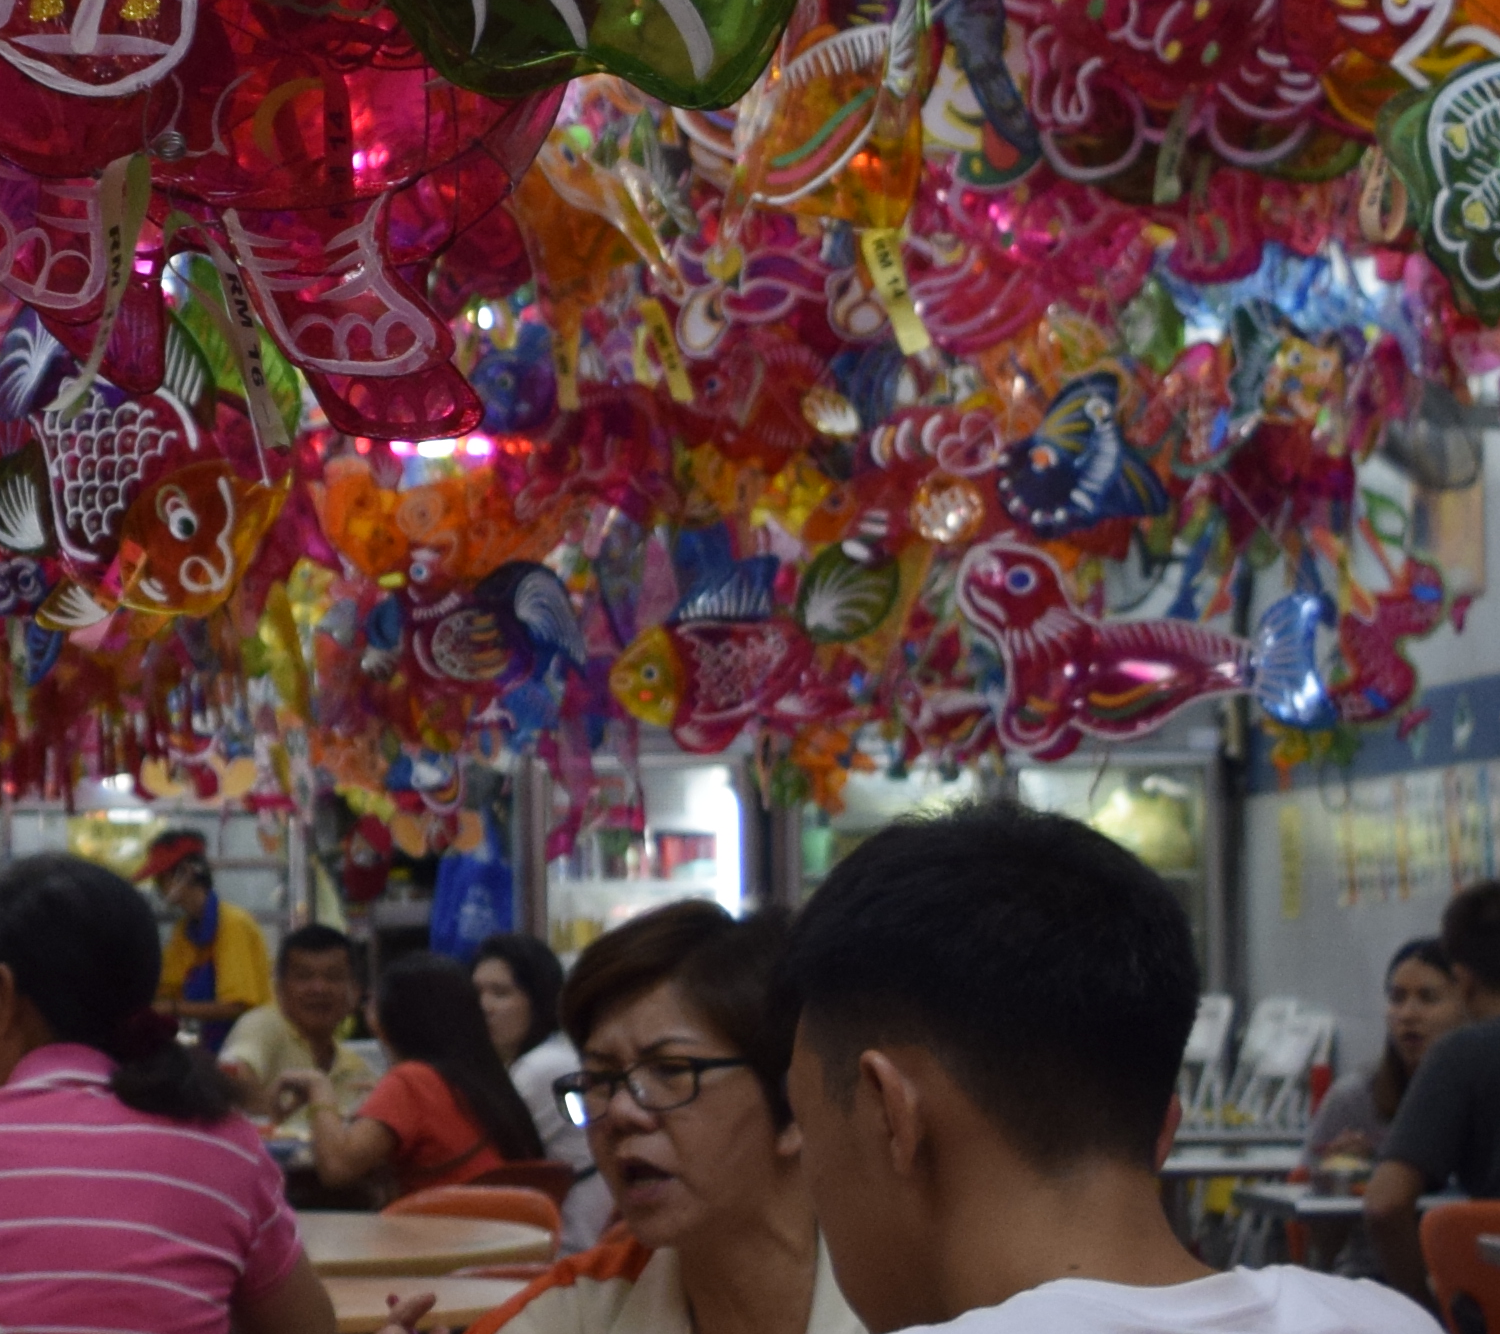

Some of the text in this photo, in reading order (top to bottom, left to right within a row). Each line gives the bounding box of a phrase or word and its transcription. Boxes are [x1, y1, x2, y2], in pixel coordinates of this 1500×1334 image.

[108, 224, 122, 288] RM
[871, 236, 905, 302] RM 14
[226, 273, 265, 393] RM 16
